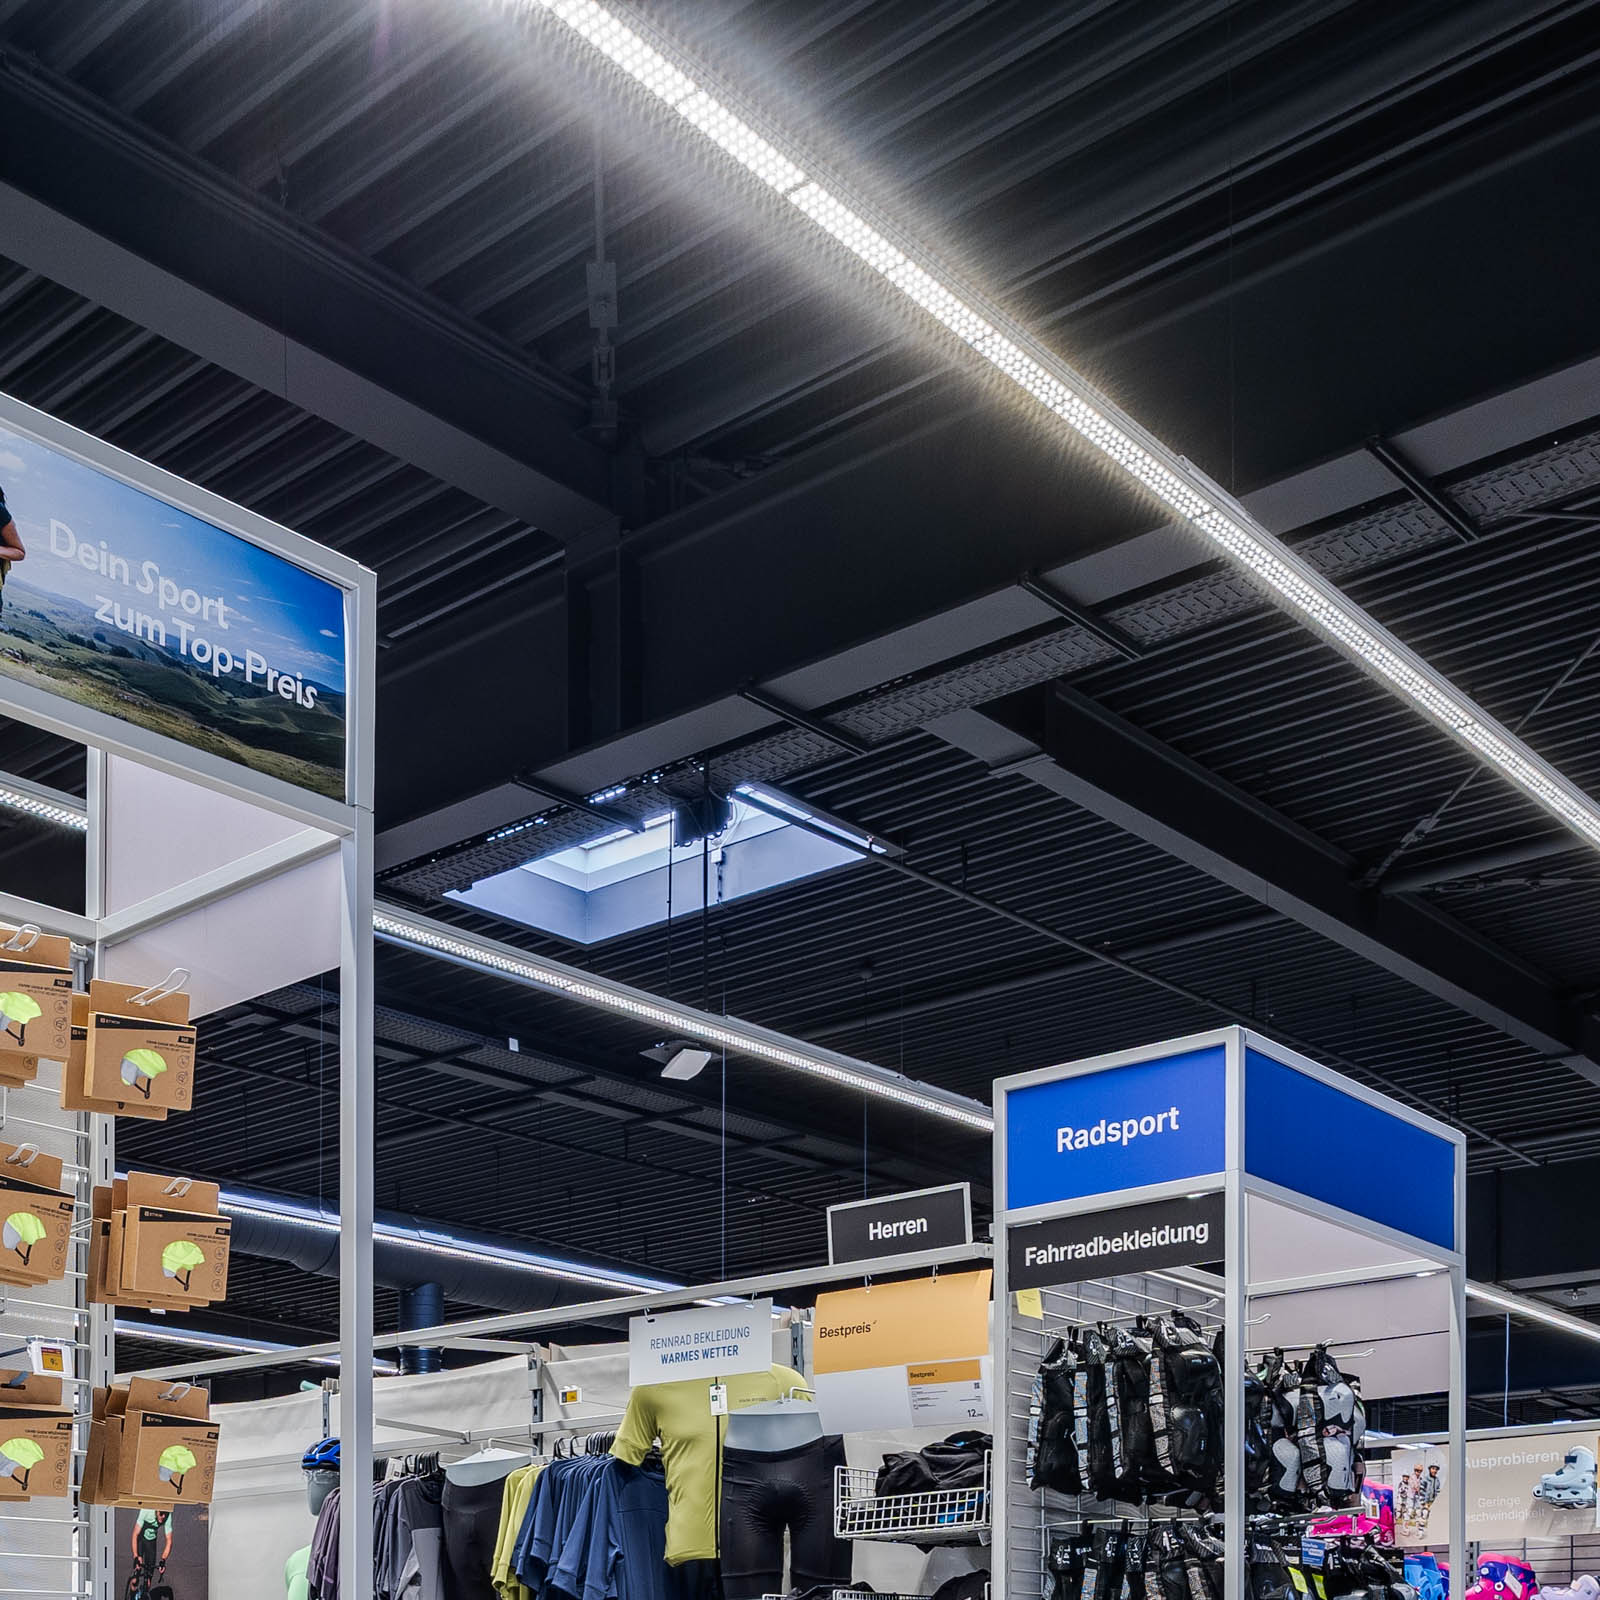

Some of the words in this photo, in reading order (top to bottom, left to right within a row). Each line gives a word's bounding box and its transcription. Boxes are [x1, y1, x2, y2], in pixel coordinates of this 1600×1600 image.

[49, 518, 129, 587] Dein
[135, 559, 229, 630] Sport
[93, 594, 166, 647] zum
[171, 616, 318, 710] Top-Preis
[1056, 1106, 1180, 1153] Radsport
[868, 1217, 928, 1241] Herren
[1024, 1220, 1210, 1267] Fahrradbekleidung
[650, 1331, 692, 1351] RENNRAD
[693, 1325, 750, 1345] BEKLEIDUNG
[819, 1320, 871, 1339] Bestpreis
[660, 1346, 700, 1365] WARMES
[701, 1344, 739, 1360] WETTER
[1466, 1508, 1545, 1523] schwindigkeit
[1477, 1495, 1521, 1512] Geringe
